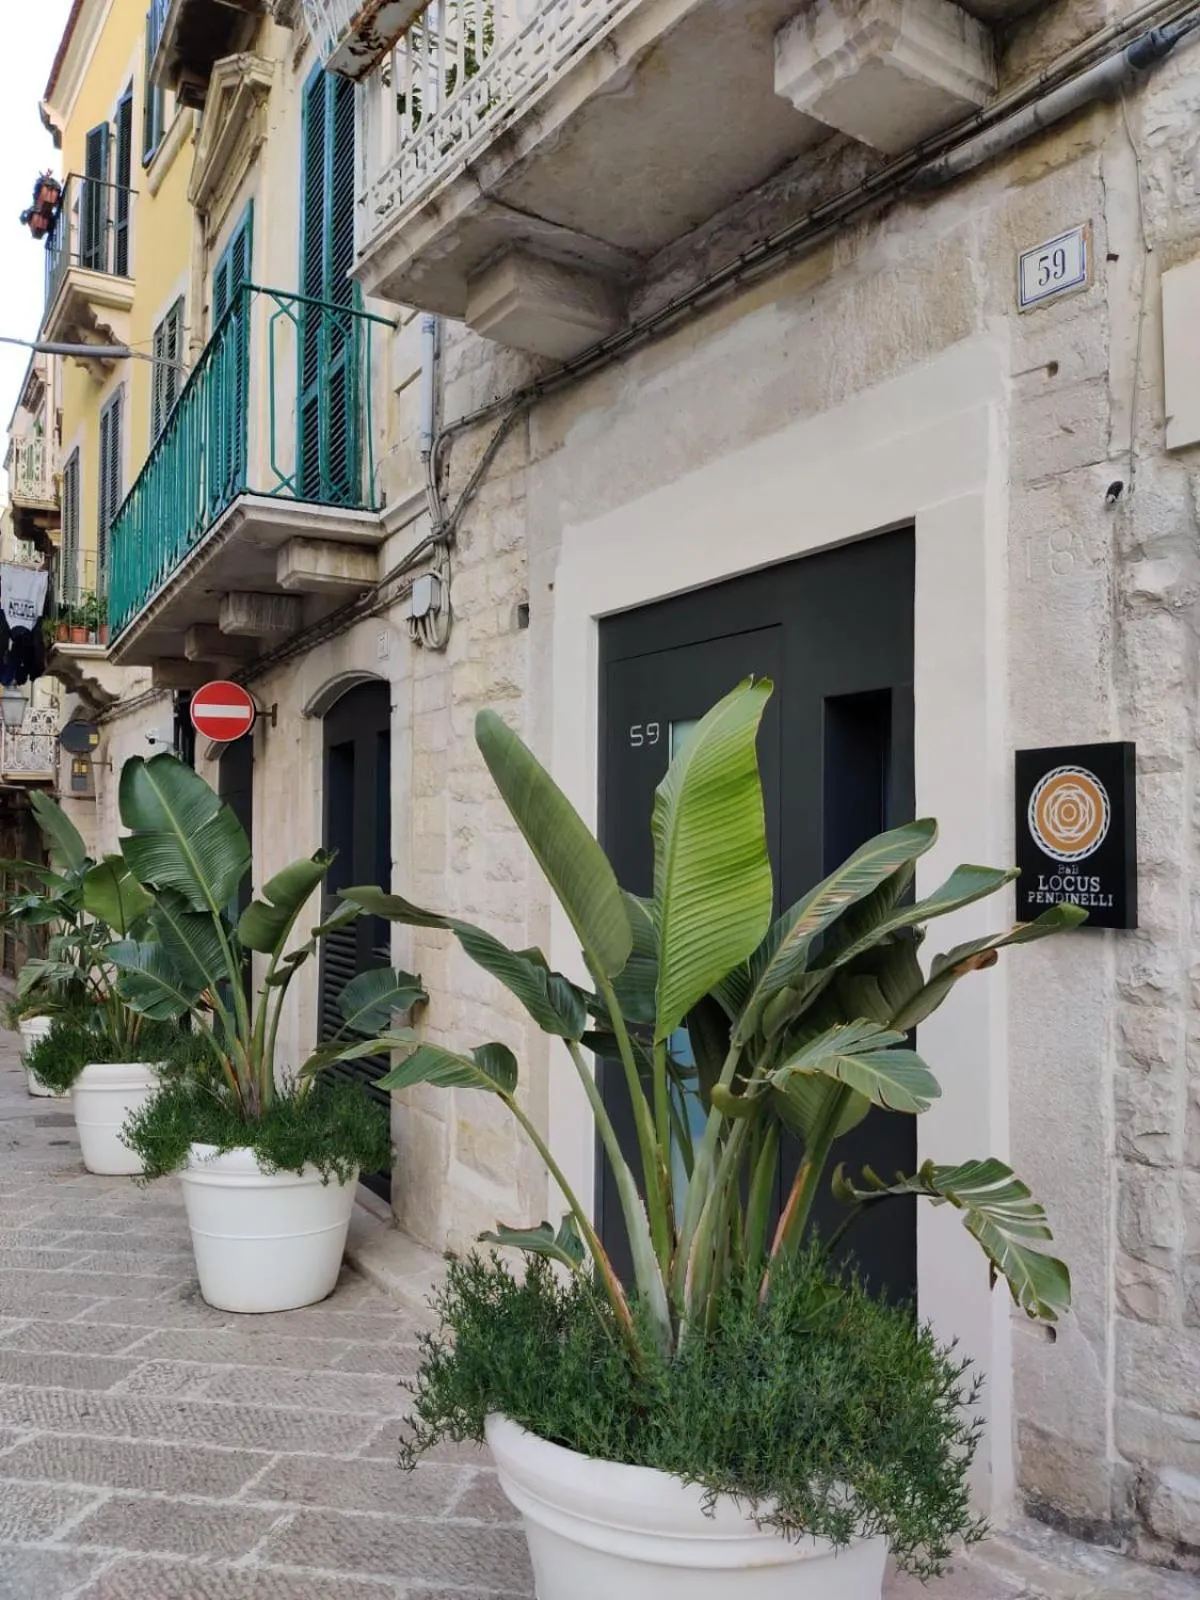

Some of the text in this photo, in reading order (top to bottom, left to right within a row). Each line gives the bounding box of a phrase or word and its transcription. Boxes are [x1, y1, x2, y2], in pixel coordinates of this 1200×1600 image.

[1038, 248, 1065, 286] 59
[630, 722, 660, 747] 59
[1038, 875, 1101, 892] LOCUS
[1028, 890, 1114, 907] PENDINELLI
